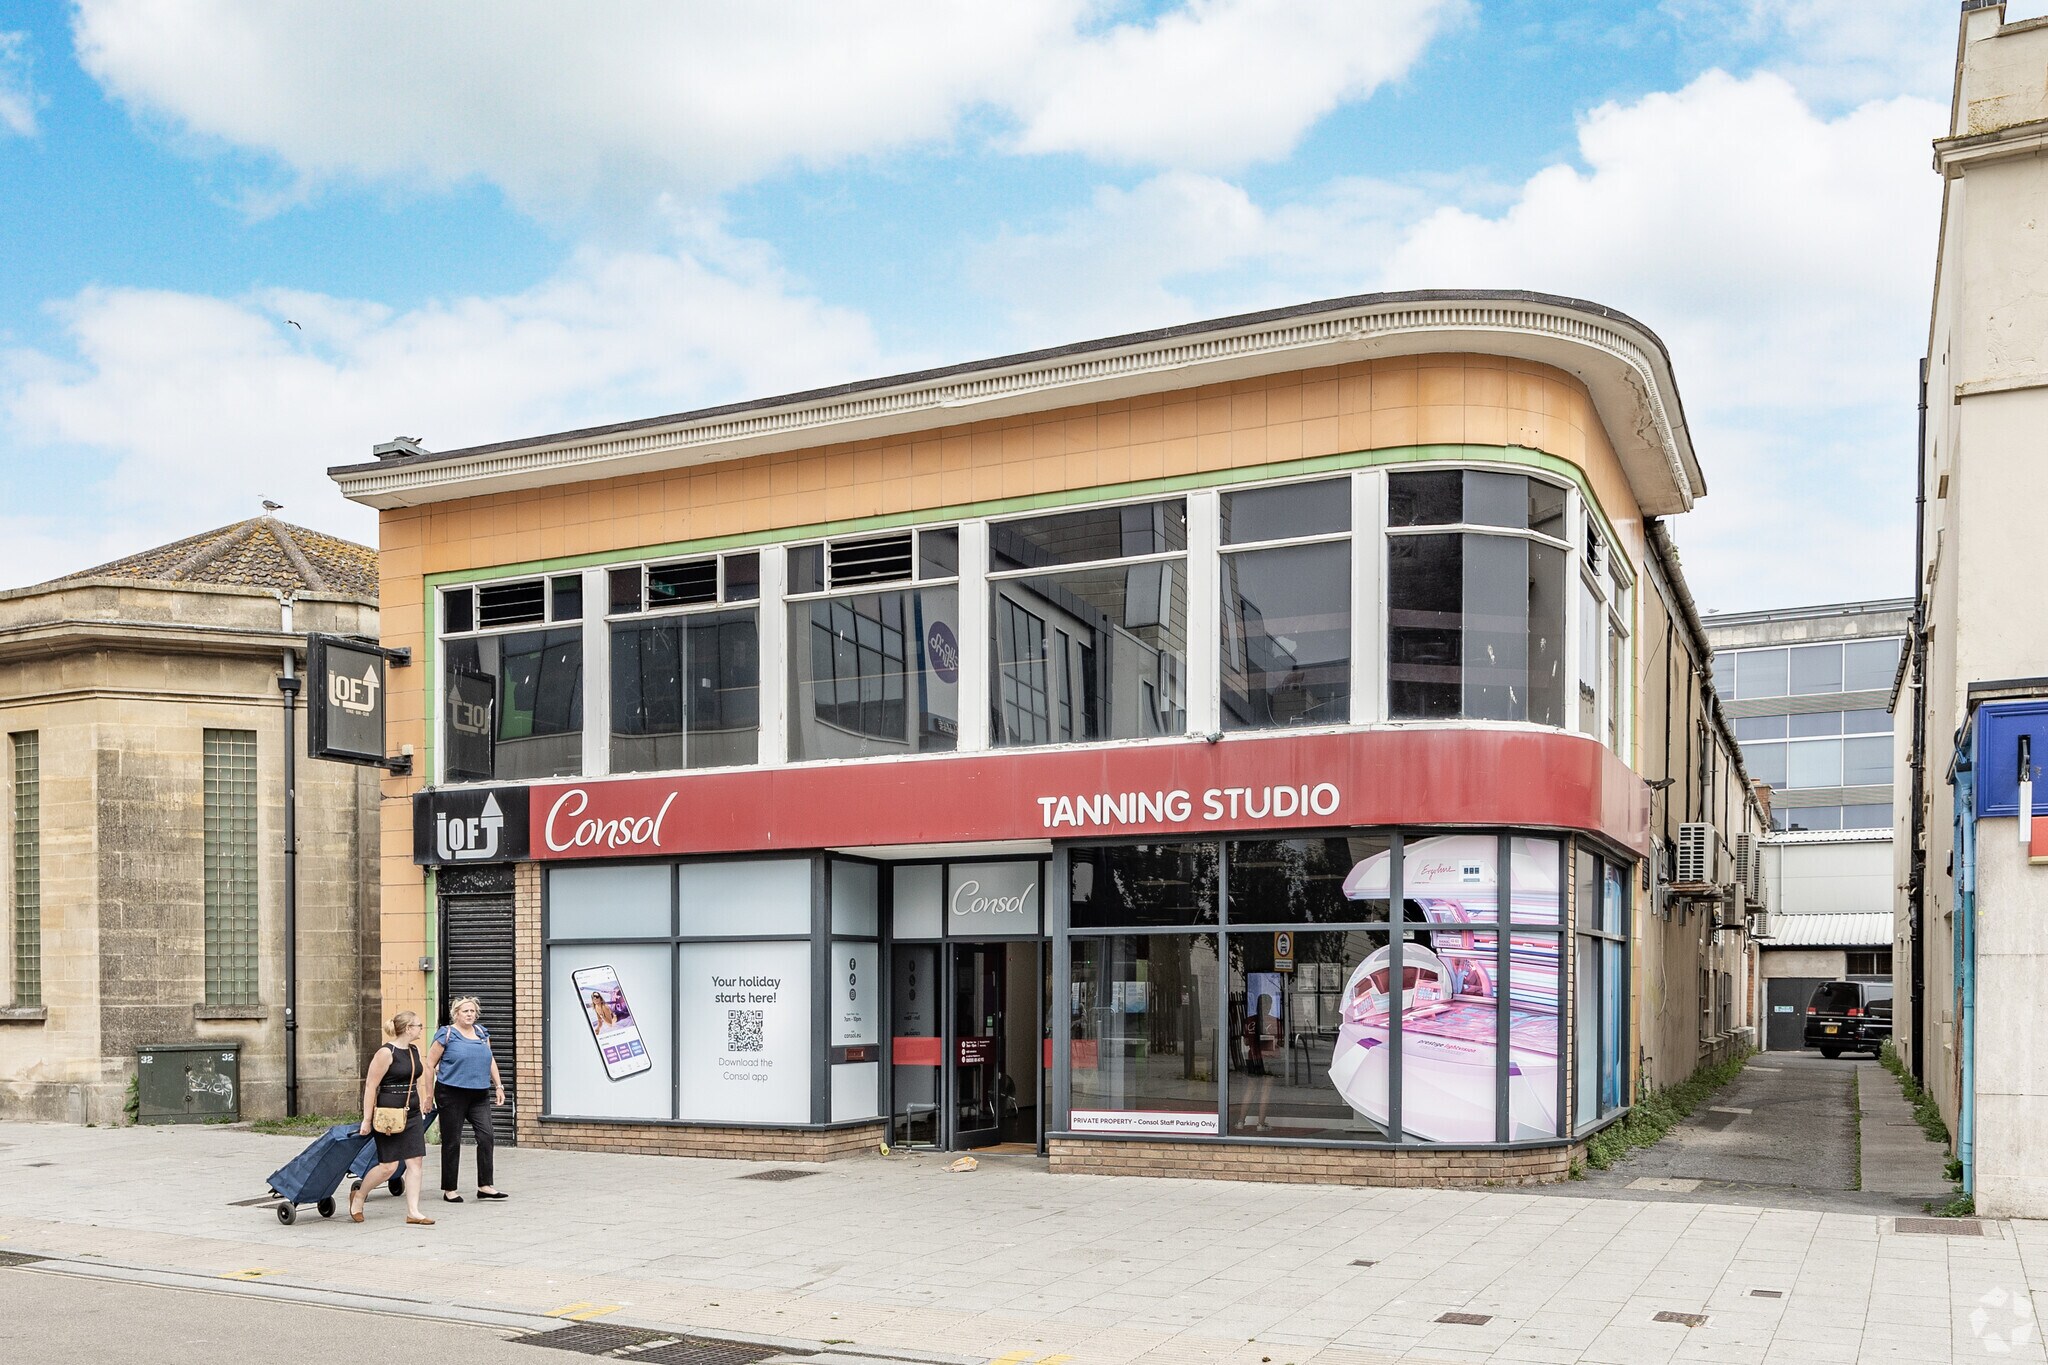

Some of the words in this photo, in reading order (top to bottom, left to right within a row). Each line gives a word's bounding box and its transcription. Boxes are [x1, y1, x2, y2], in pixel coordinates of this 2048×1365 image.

[328, 672, 380, 712] LOFT
[1037, 789, 1192, 828] TANNING
[1203, 782, 1340, 821] STUDIO
[545, 789, 679, 852] Consol
[437, 815, 504, 860] LOFT
[952, 880, 1035, 915] Consol
[712, 976, 737, 987] Your
[739, 976, 781, 990] holiday
[715, 992, 746, 1003] starts
[748, 992, 777, 1003] here!
[140, 1055, 153, 1064] 32
[221, 1053, 234, 1061] 32
[718, 1057, 759, 1067] Download
[760, 1058, 774, 1068] the
[723, 1071, 750, 1081] Consol
[751, 1073, 768, 1083] app
[1138, 1118, 1159, 1126] Consol
[1176, 1119, 1200, 1127] Parking
[1200, 1120, 1217, 1128] Only.
